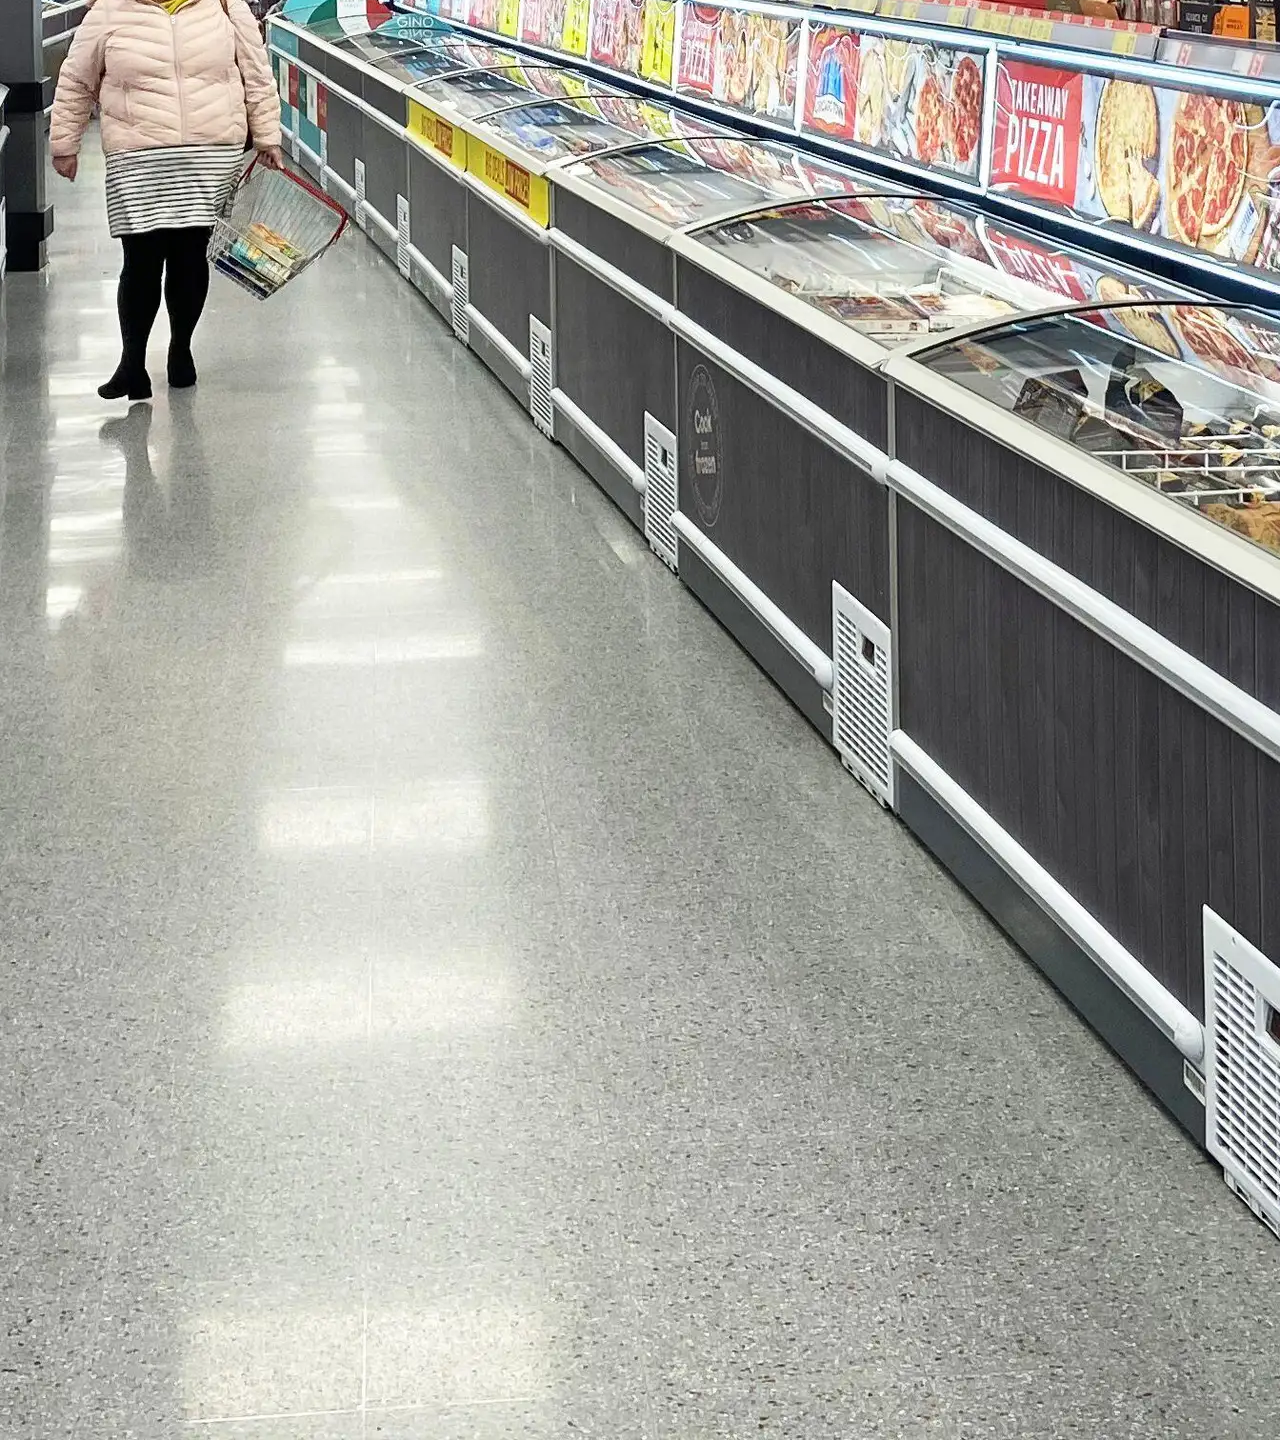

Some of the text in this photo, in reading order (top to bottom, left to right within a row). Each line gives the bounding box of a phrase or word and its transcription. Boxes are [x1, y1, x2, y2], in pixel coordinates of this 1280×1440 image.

[396, 14, 434, 28] GINO
[1011, 79, 1069, 120] TAKEAWAY
[1005, 117, 1065, 189] PIZZA
[694, 408, 713, 434] Cook
[695, 450, 716, 475] frozen
